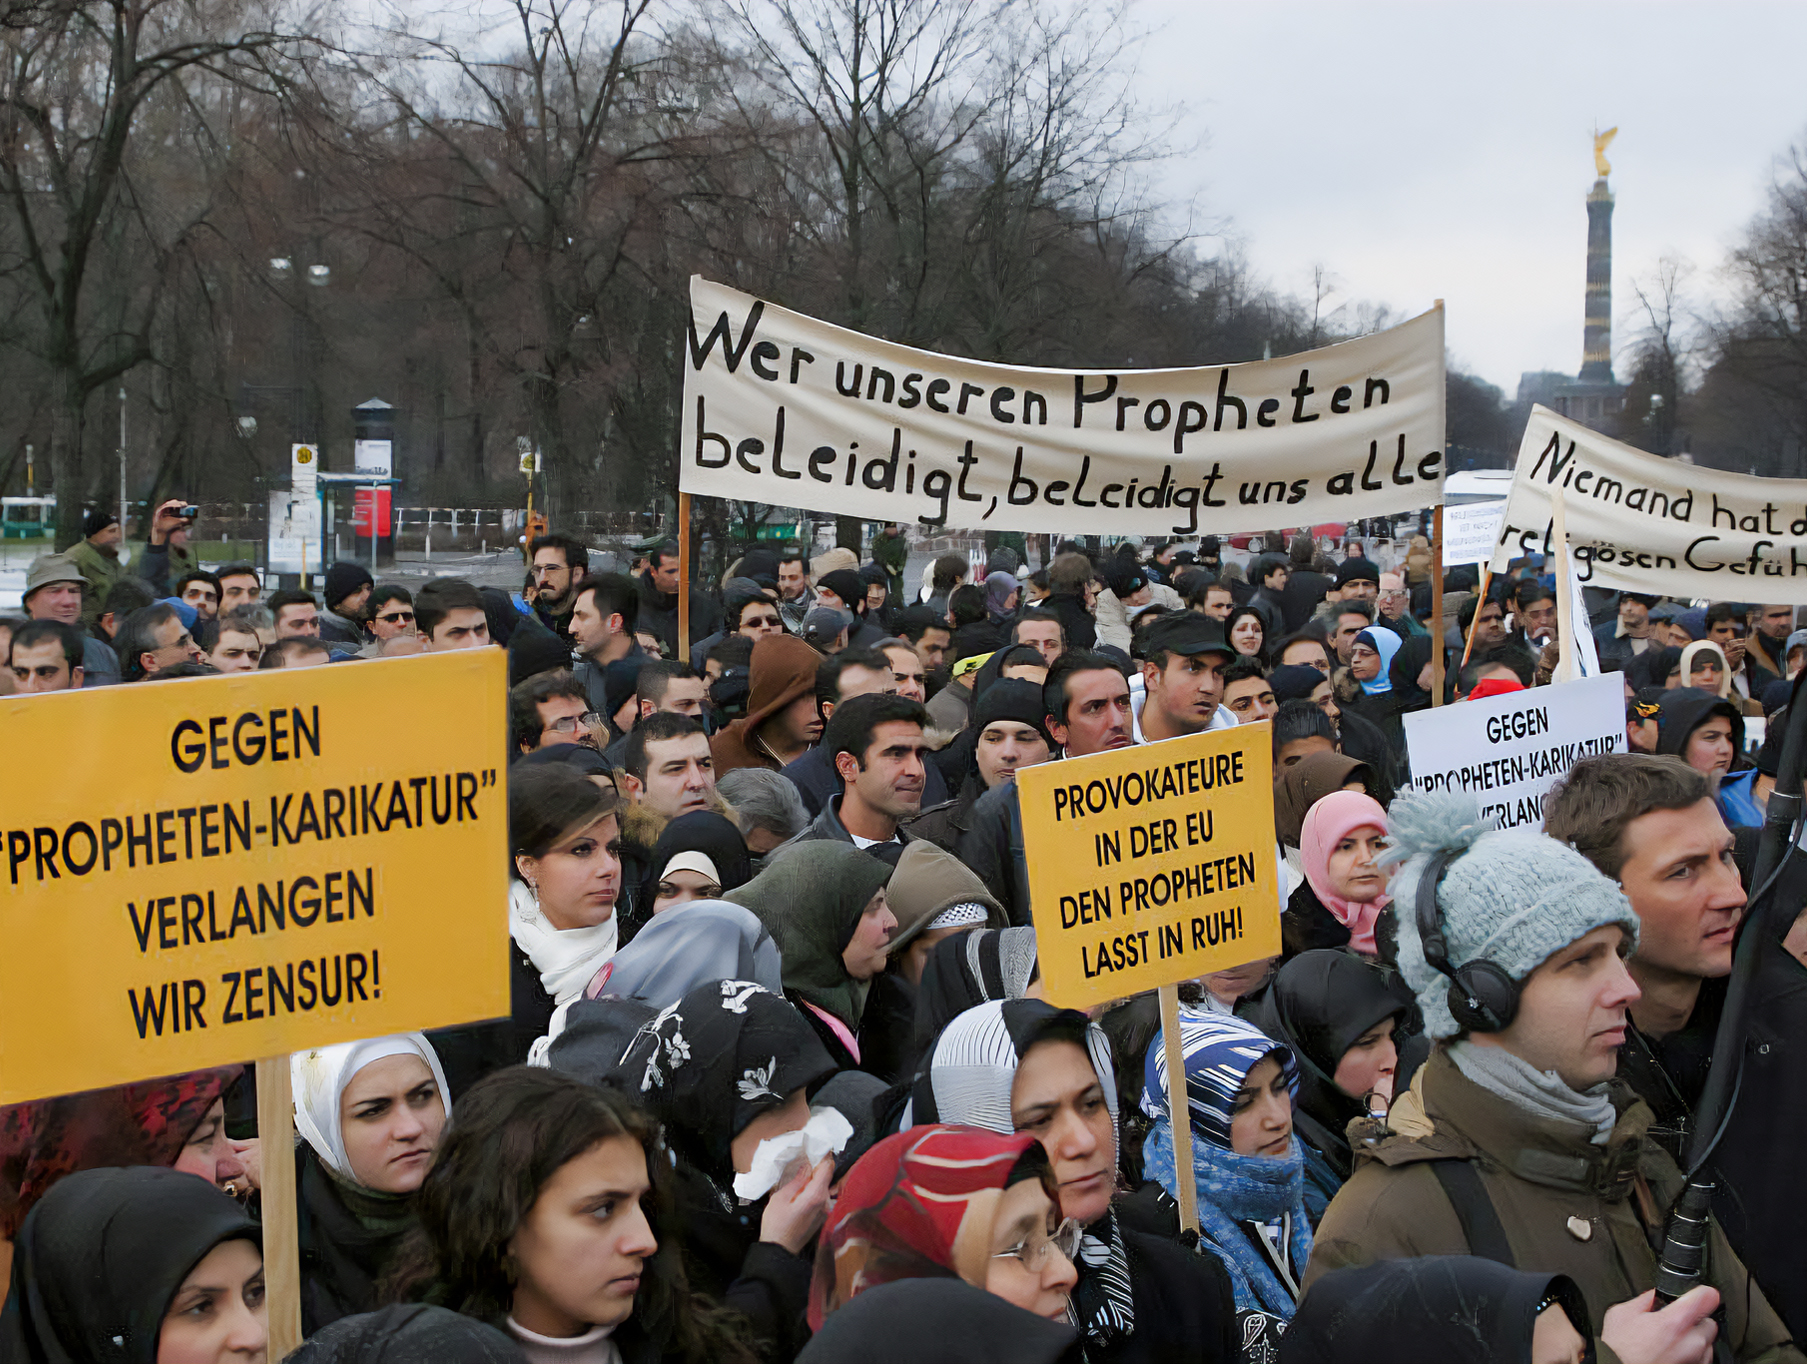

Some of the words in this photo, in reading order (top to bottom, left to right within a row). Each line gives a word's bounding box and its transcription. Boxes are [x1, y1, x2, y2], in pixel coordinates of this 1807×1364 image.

[688, 300, 815, 384] Wer
[835, 359, 1047, 425] unseren
[1073, 367, 1391, 454] Propheten
[1238, 477, 1311, 505] uns
[1530, 430, 1693, 523] Niemand
[1712, 492, 1784, 535] hat
[1500, 516, 1676, 582] relgiösen
[170, 704, 322, 774] GEGEN
[1486, 706, 1549, 744] GEGEN
[1053, 750, 1244, 822] PROVOKATEURE
[0, 768, 498, 885] PROPHETEN-KARIKATUR”
[1094, 829, 1122, 868] IN
[1129, 818, 1179, 859] DER
[1185, 809, 1214, 846] EU
[127, 867, 375, 954] VERLANGEN
[1059, 886, 1112, 930] DEN
[1119, 851, 1256, 916] PROPHETEN
[1081, 930, 1149, 979] LASST
[1157, 922, 1184, 960] IN
[1190, 906, 1244, 950] RUH!
[127, 979, 207, 1040] WIR
[221, 949, 382, 1025] ZENSUR!
